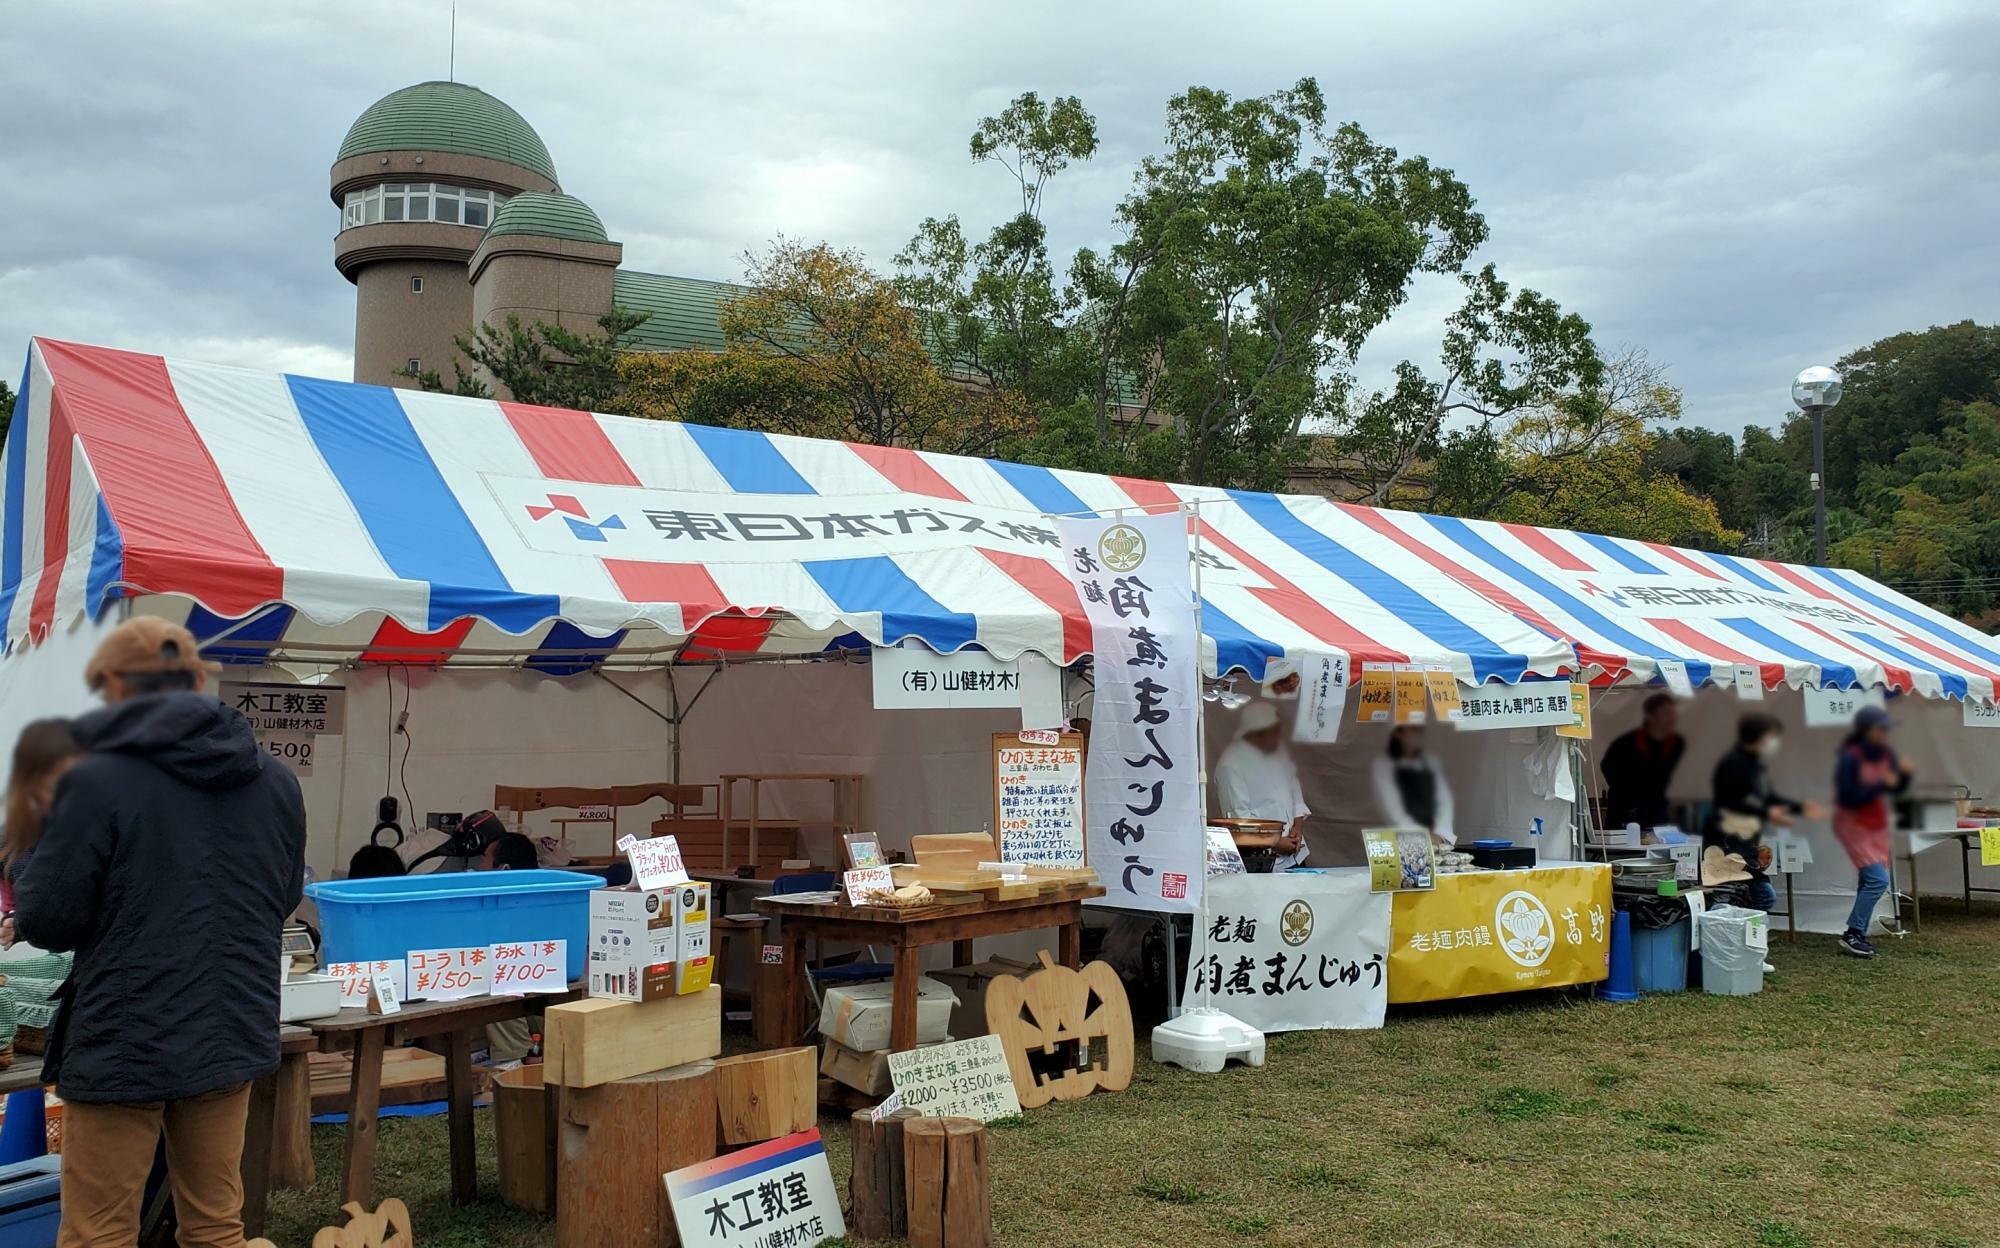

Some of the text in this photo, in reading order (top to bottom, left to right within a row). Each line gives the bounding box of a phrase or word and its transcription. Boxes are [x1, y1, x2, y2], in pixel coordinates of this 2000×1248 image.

[236, 691, 327, 713] 木工教室
[1461, 698, 1544, 716] 老麺肉まん専門店
[1020, 731, 1056, 743] おすすめ
[259, 742, 311, 758] 500
[1000, 774, 1026, 784] ひのき
[1209, 915, 1257, 943] 老麺
[1411, 925, 1493, 951] 老麺肉饅
[1193, 952, 1383, 995] 角煮まんじゅう
[704, 1171, 812, 1239] 木工教室
